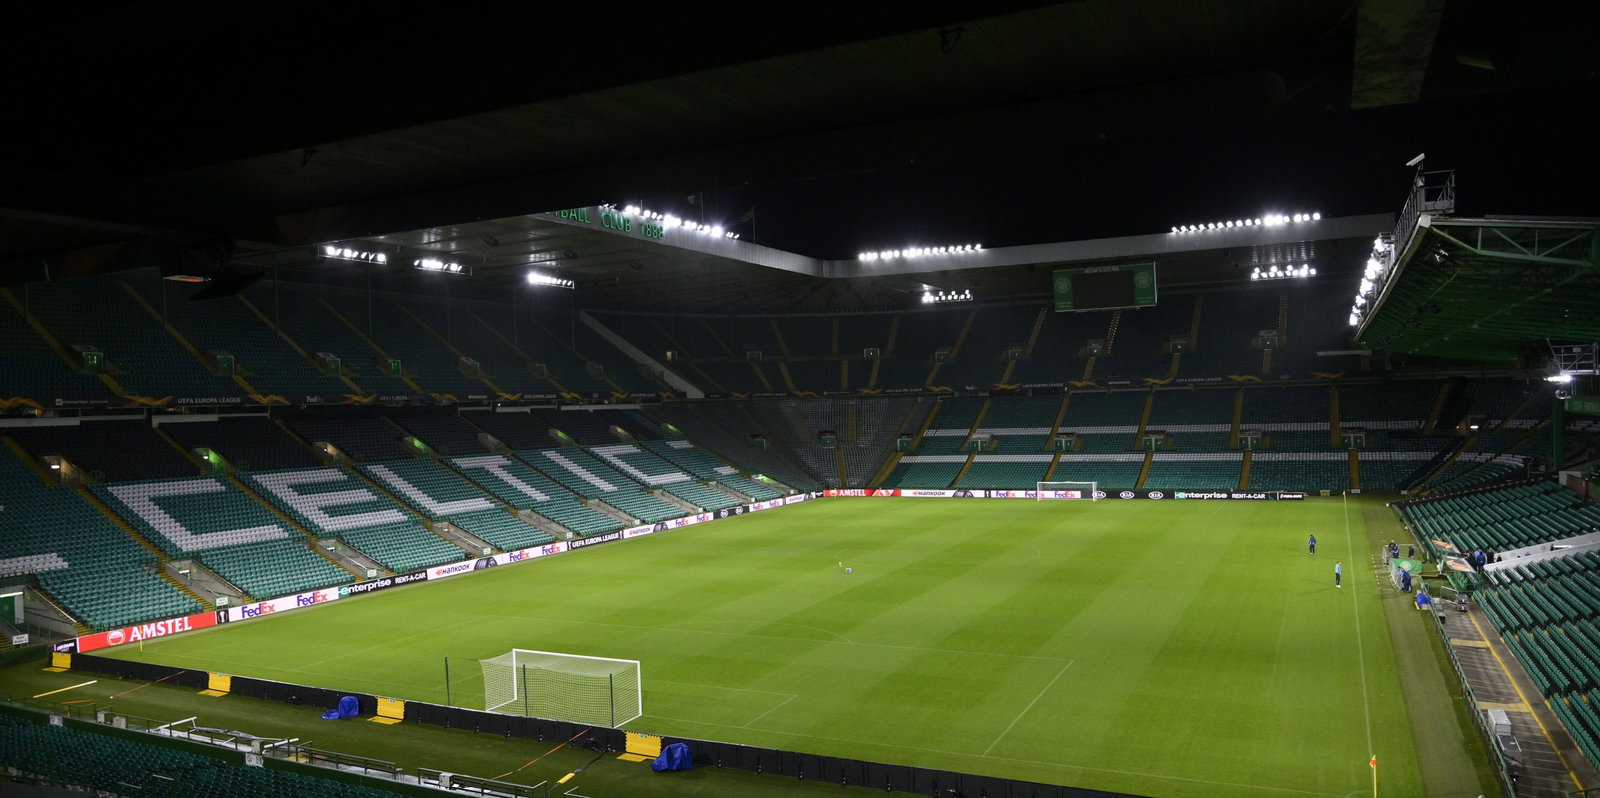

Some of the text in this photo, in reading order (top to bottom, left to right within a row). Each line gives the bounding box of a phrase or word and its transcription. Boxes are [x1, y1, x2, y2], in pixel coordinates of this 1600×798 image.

[601, 211, 632, 232] CLUB
[640, 221, 664, 240] 1888
[107, 444, 692, 552] CELTIC
[839, 489, 866, 497] AMSTEL
[995, 490, 1016, 498] FedEx
[1054, 490, 1076, 498] FedEx
[1175, 491, 1228, 500] enterprise
[572, 532, 619, 548] UEFA EUROPA LEAGUE
[509, 550, 530, 563] FedEx
[541, 544, 561, 556] FedEx
[340, 572, 426, 595] enterprise RENT-A-CAR
[296, 591, 328, 607] FedEx
[241, 602, 275, 619] FedEx
[129, 616, 192, 642] AMSTEL
